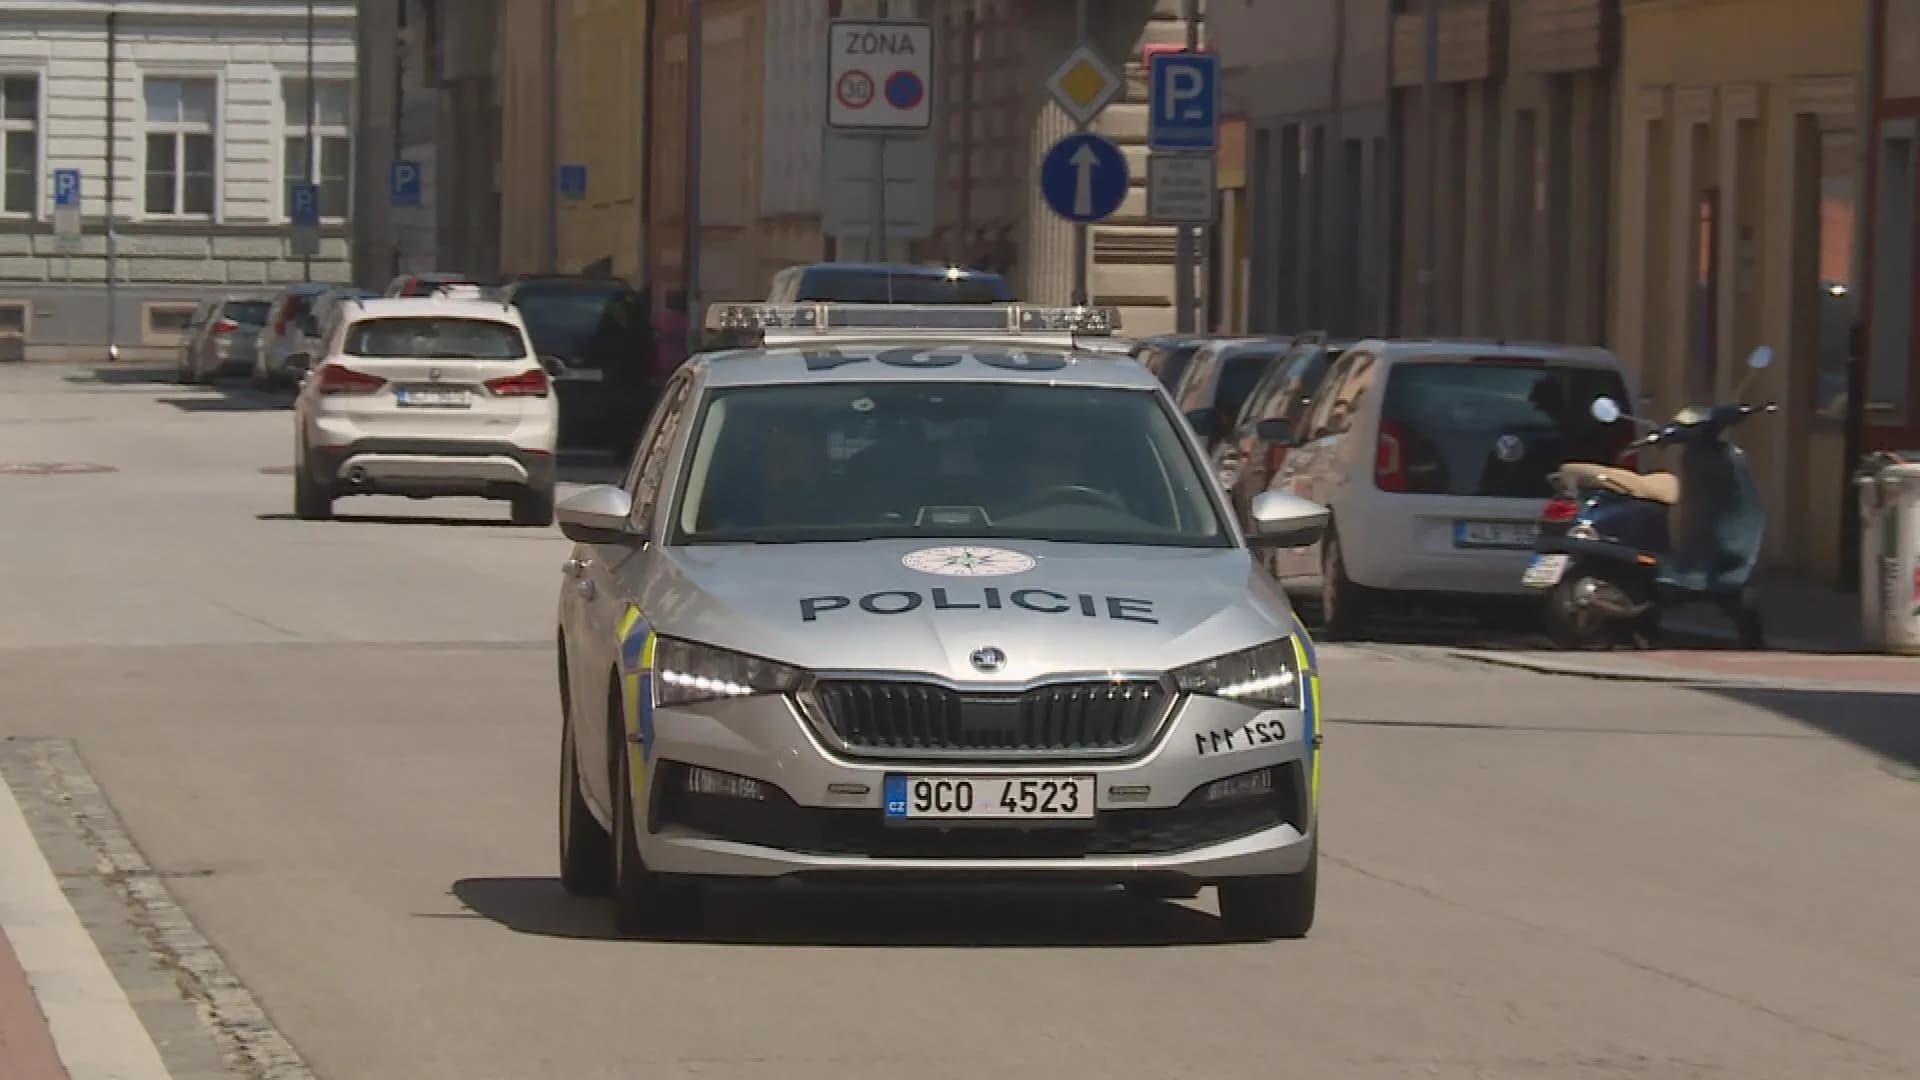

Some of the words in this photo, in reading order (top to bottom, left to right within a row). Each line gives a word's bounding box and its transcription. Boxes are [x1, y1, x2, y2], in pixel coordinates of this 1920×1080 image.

[1165, 66, 1202, 120] P
[58, 172, 76, 195] P
[395, 165, 416, 193] P
[799, 587, 1159, 625] POLICIE
[999, 780, 1079, 813] 4523
